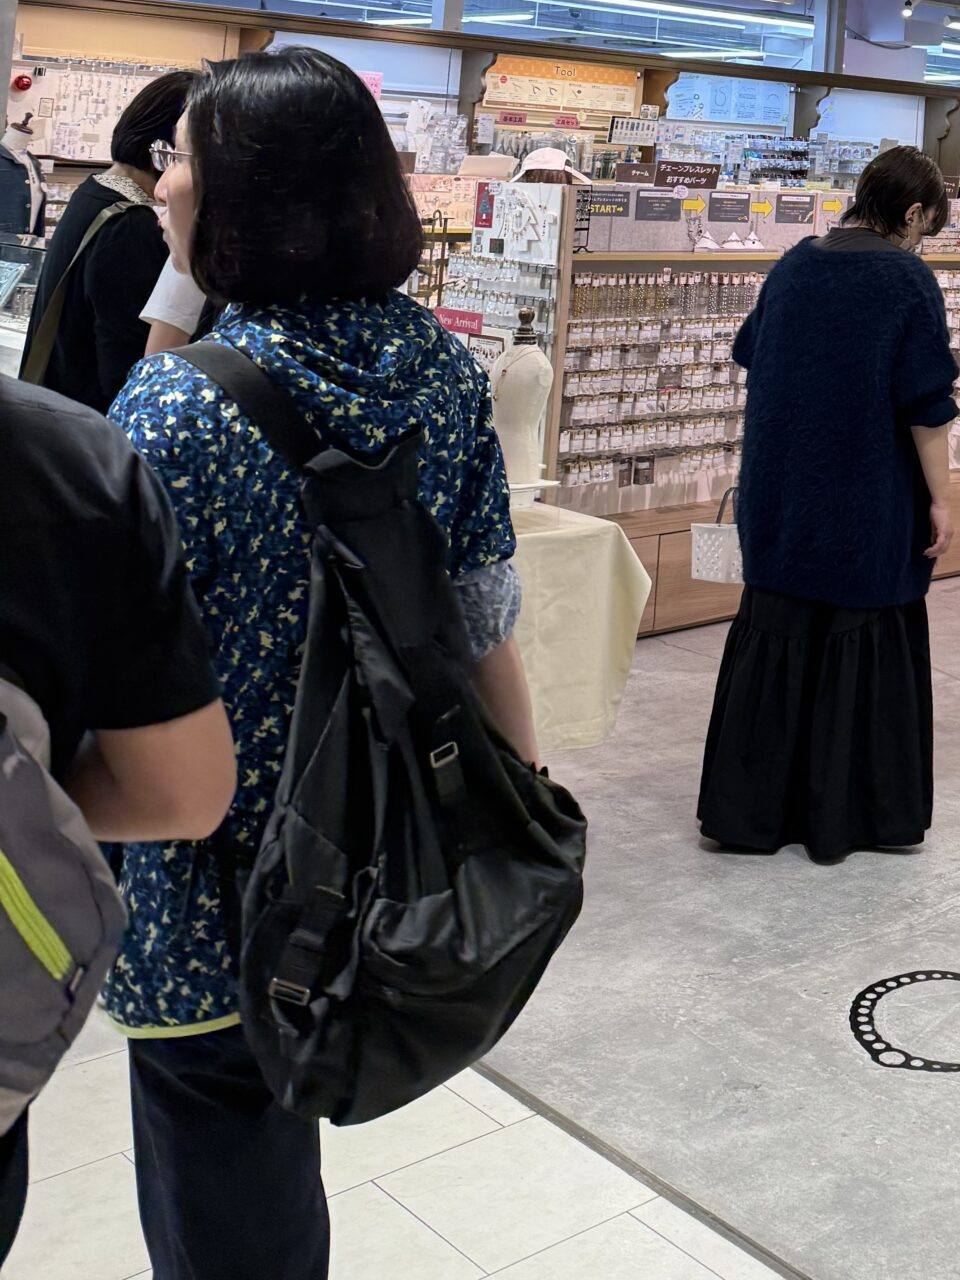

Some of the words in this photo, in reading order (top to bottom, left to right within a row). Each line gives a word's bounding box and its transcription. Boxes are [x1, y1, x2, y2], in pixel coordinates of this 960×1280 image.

[554, 65, 576, 77] Tool
[666, 176, 707, 185] おすすめパーツ
[590, 204, 617, 213] START
[439, 313, 453, 326] New
[454, 315, 478, 330] Arrival
